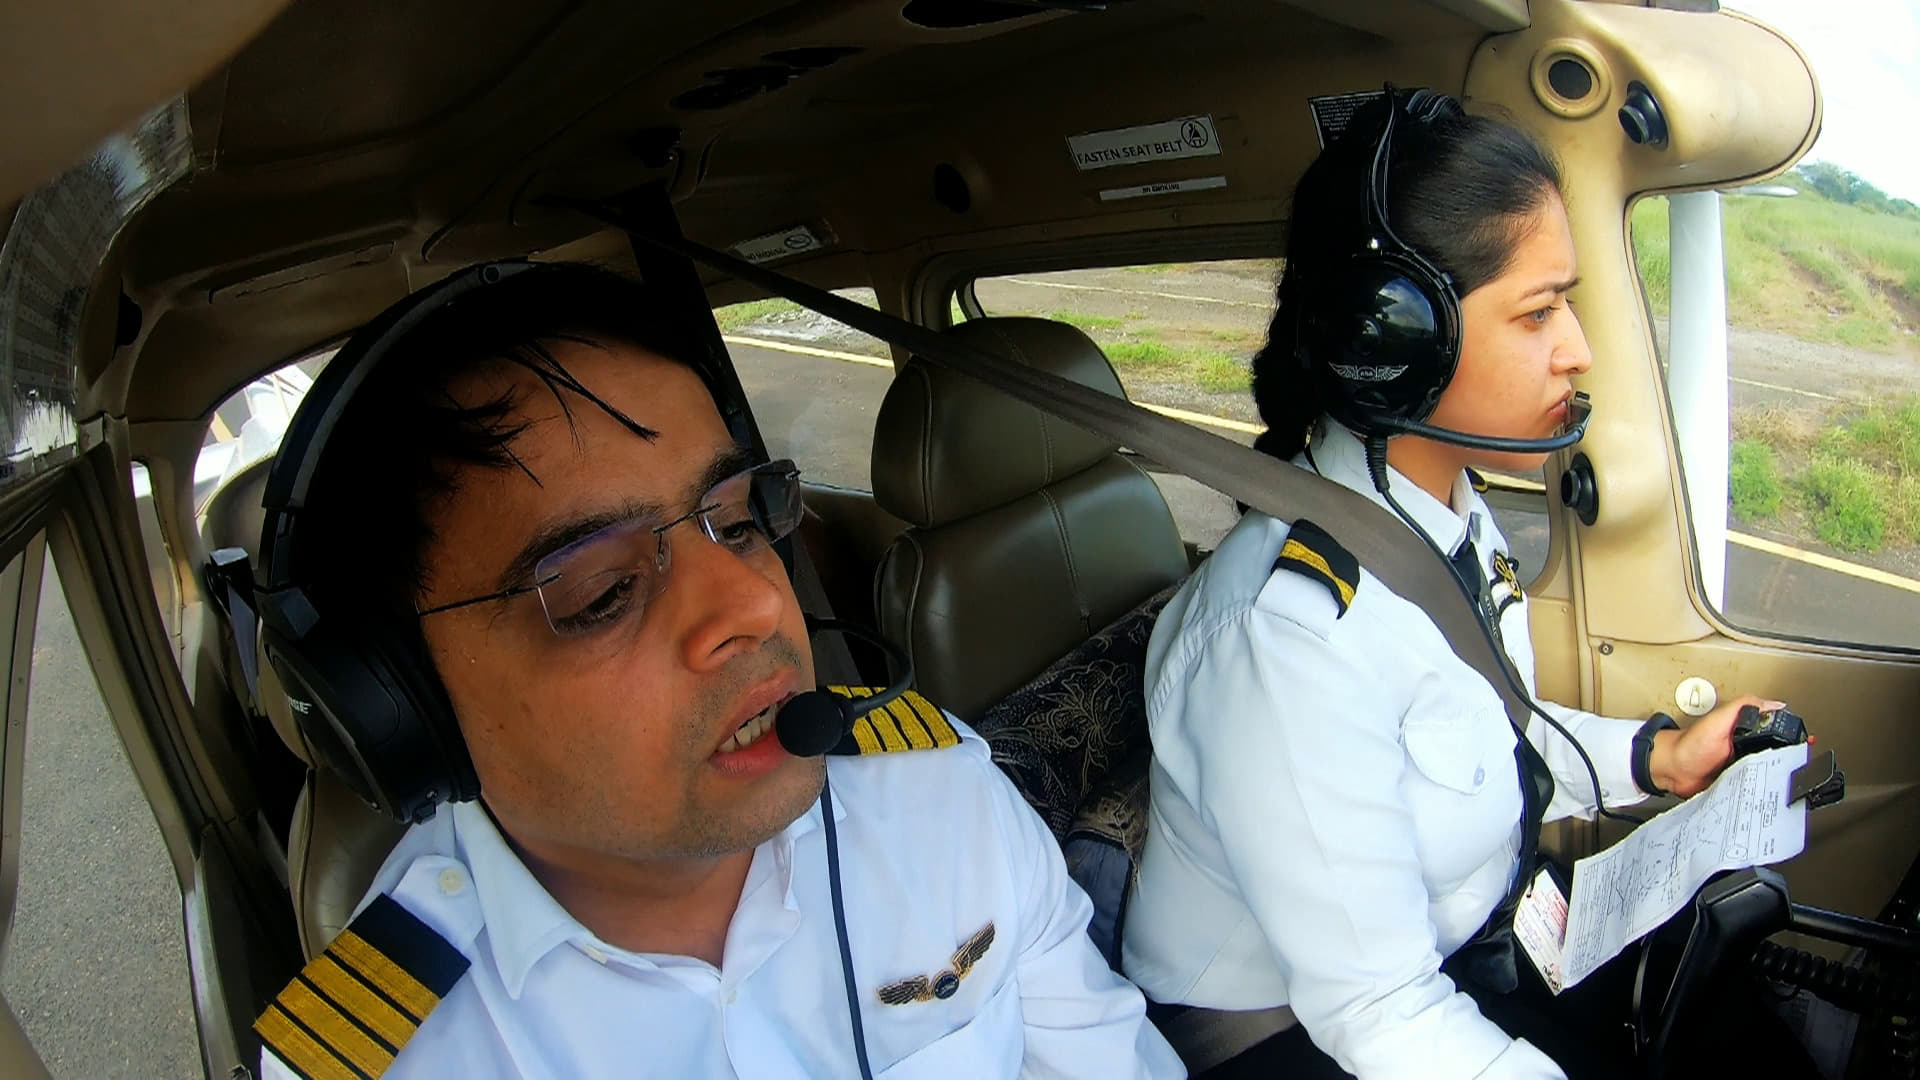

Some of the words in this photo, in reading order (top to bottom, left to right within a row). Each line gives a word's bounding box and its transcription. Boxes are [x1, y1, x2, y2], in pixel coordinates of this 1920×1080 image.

[1077, 149, 1121, 164] FASTEN
[1122, 145, 1151, 158] SEAT
[1154, 140, 1183, 154] BELT
